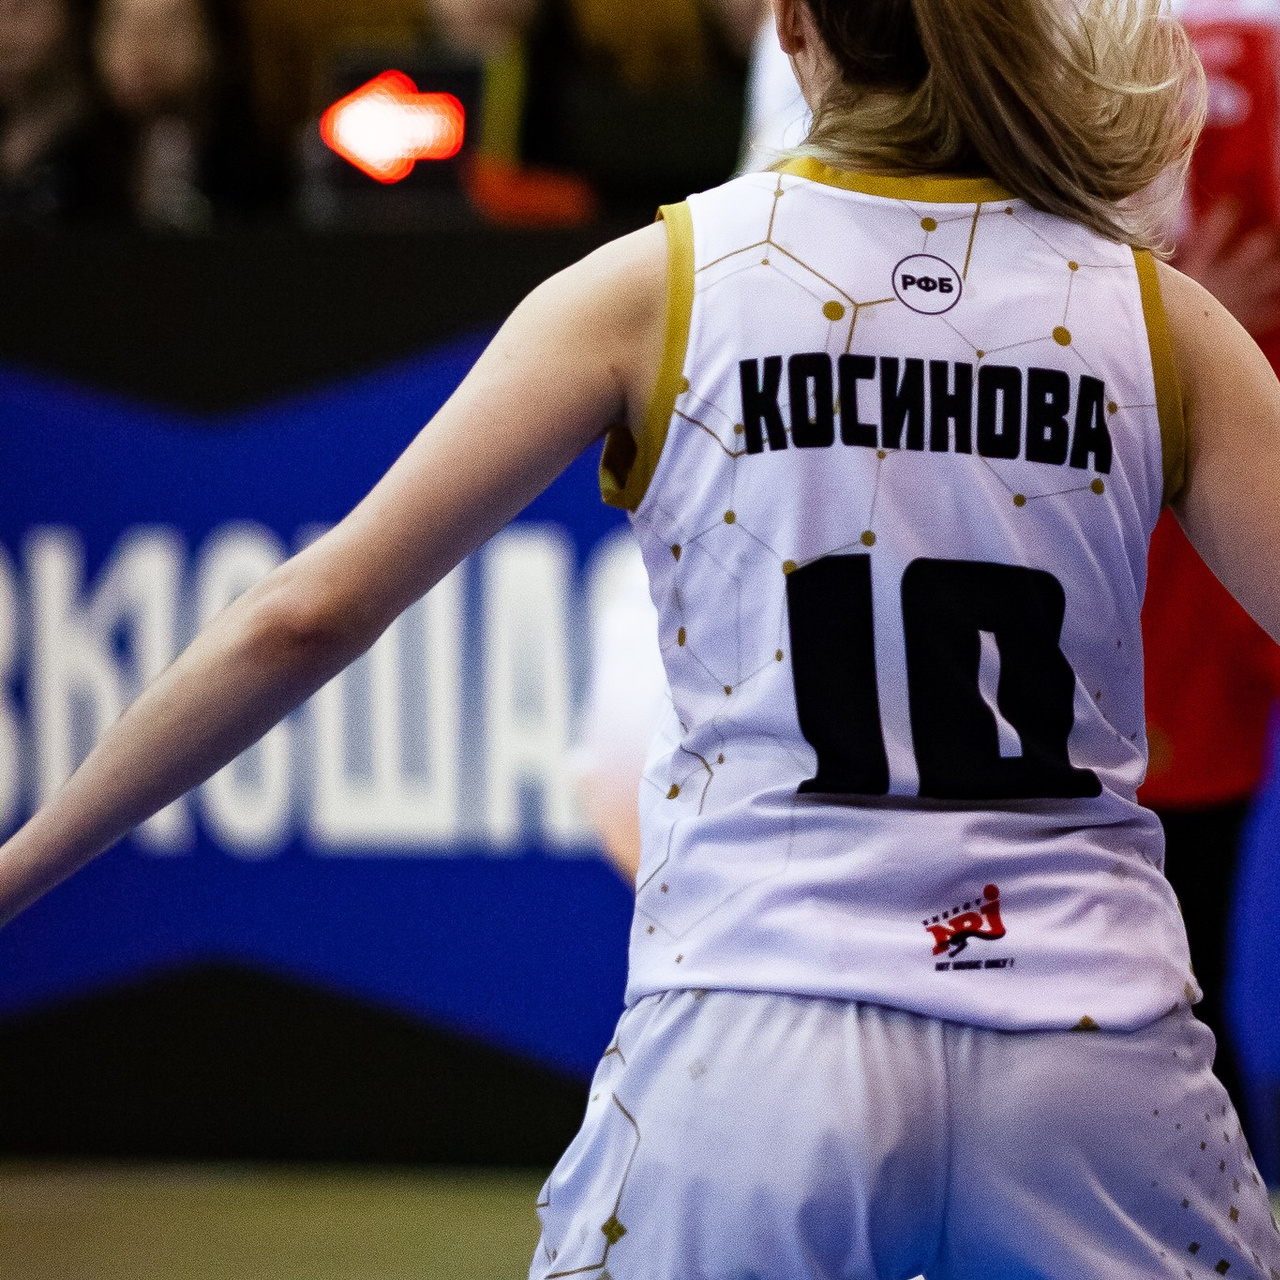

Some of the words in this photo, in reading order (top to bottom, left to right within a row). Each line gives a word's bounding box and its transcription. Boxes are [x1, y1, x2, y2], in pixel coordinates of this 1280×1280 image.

[901, 274, 953, 294] РФБ
[740, 353, 1113, 475] КОСИНОВА
[786, 554, 1103, 801] 10
